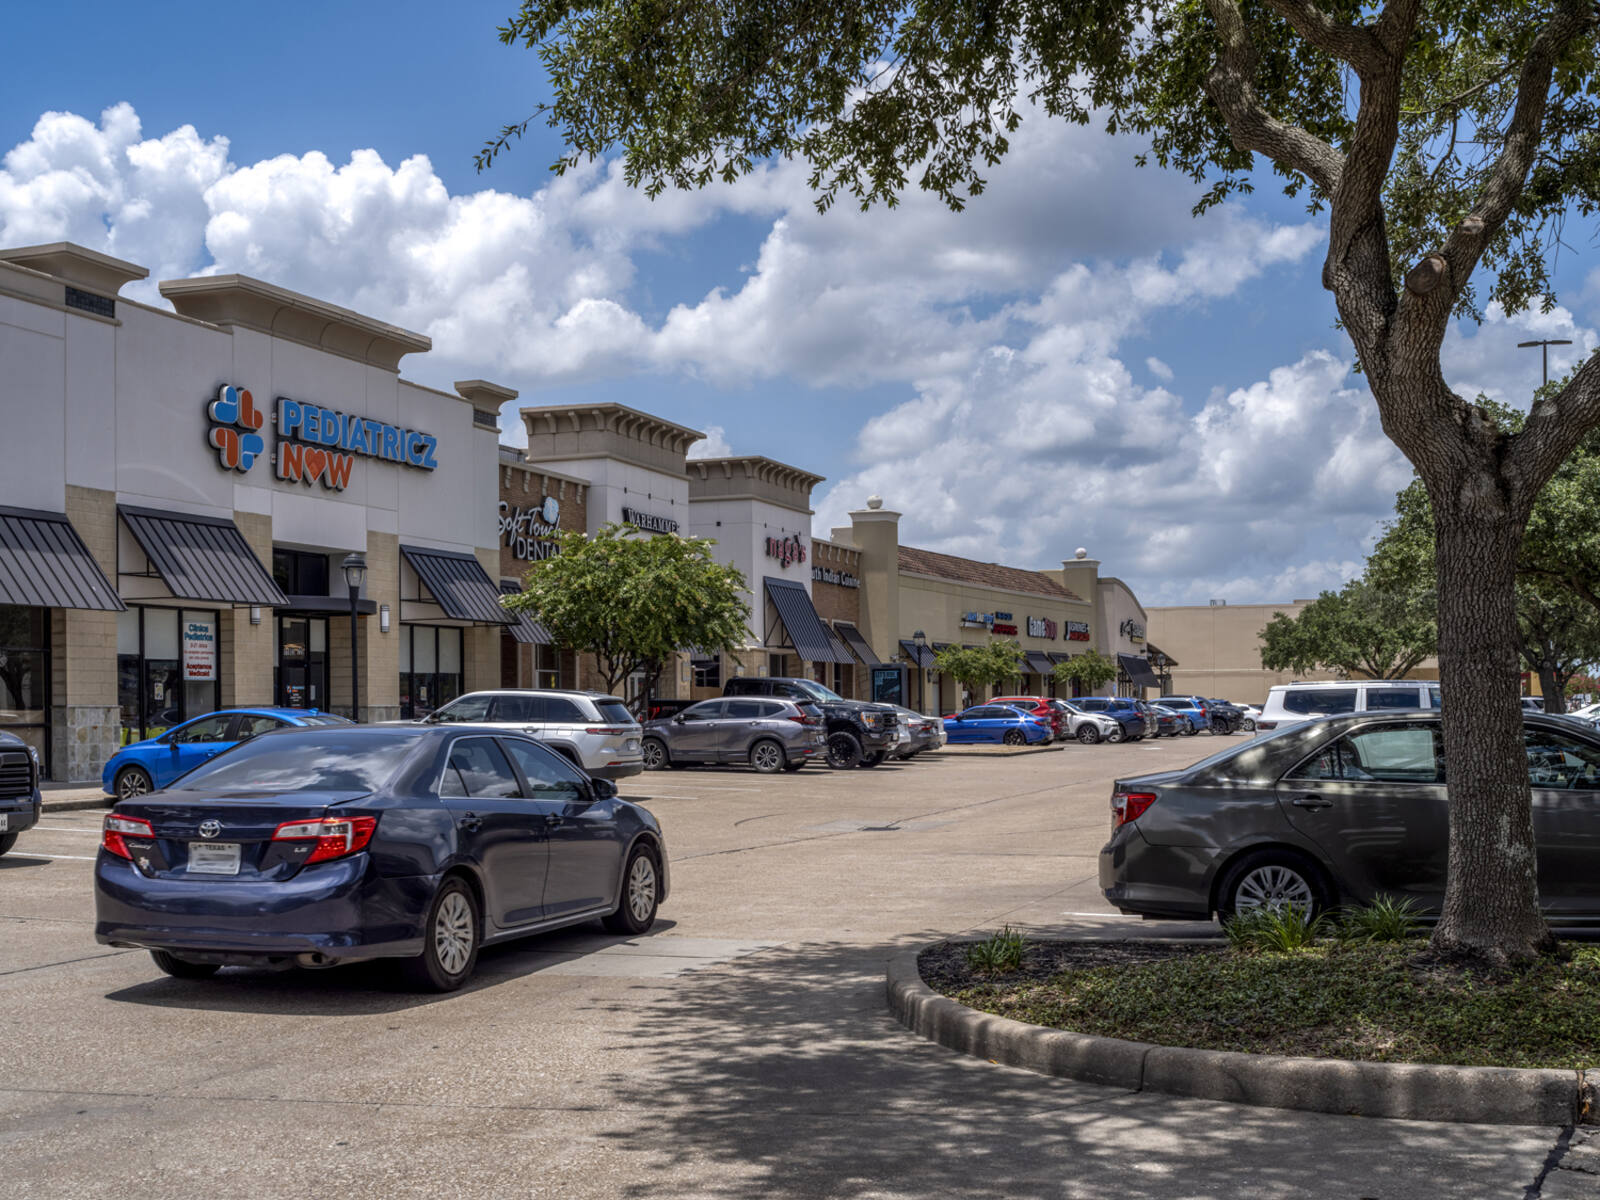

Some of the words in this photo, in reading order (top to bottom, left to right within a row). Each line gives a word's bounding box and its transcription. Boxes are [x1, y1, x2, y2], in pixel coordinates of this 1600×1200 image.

[280, 399, 438, 468] PEDIATRICZ
[498, 501, 531, 546] Soft
[528, 506, 562, 539] Touch
[626, 508, 680, 532] WARHAMME
